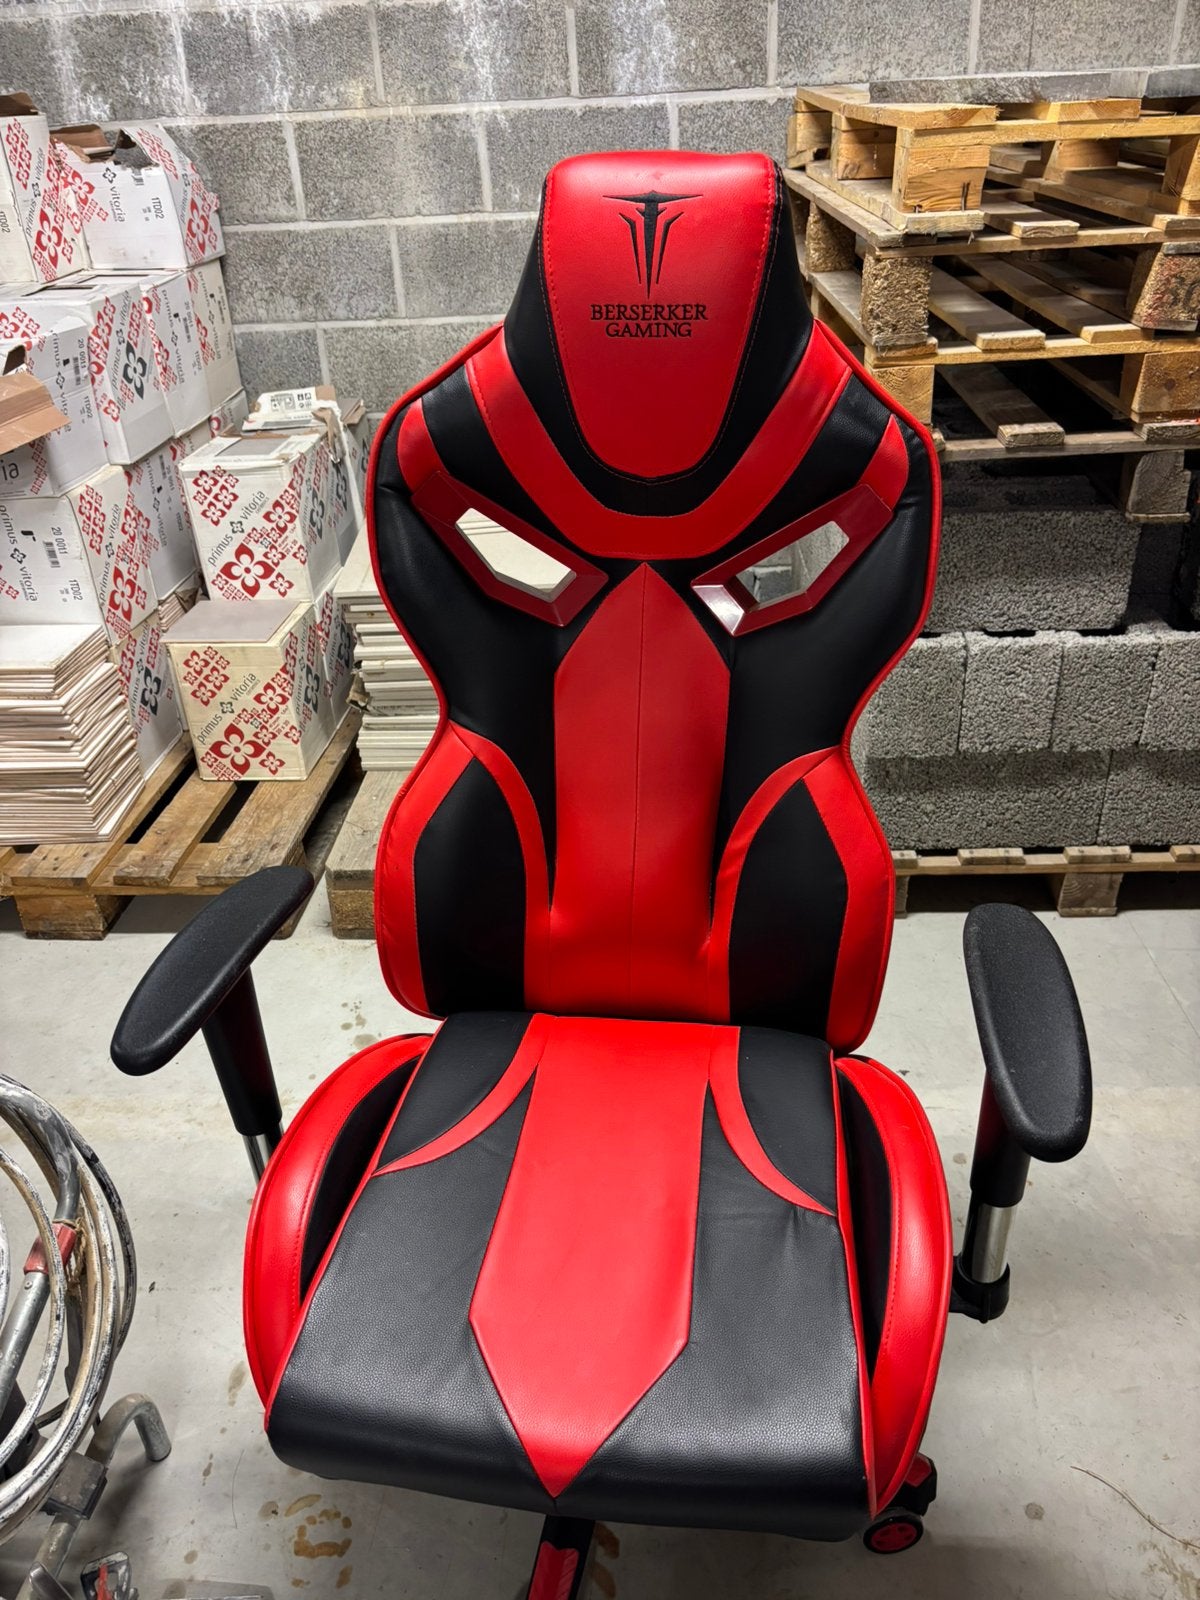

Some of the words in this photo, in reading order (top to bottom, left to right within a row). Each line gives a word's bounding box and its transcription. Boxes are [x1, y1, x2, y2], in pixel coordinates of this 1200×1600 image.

[110, 186, 126, 222] vitoria
[152, 197, 165, 219] 1TD02
[590, 304, 708, 321] BERSERKER
[605, 322, 692, 338] GAMING
[51, 329, 61, 368] rimus
[111, 347, 122, 390] primus
[51, 527, 62, 536] 20
[55, 537, 68, 555] 0011
[207, 533, 234, 567] primus
[240, 490, 266, 520] vitoria
[99, 561, 111, 604] primus
[108, 503, 120, 539] vitoria
[20, 565, 38, 602] vitoria
[68, 579, 83, 601] 1TD02
[196, 713, 223, 746] primus
[230, 673, 257, 701] vitoria
